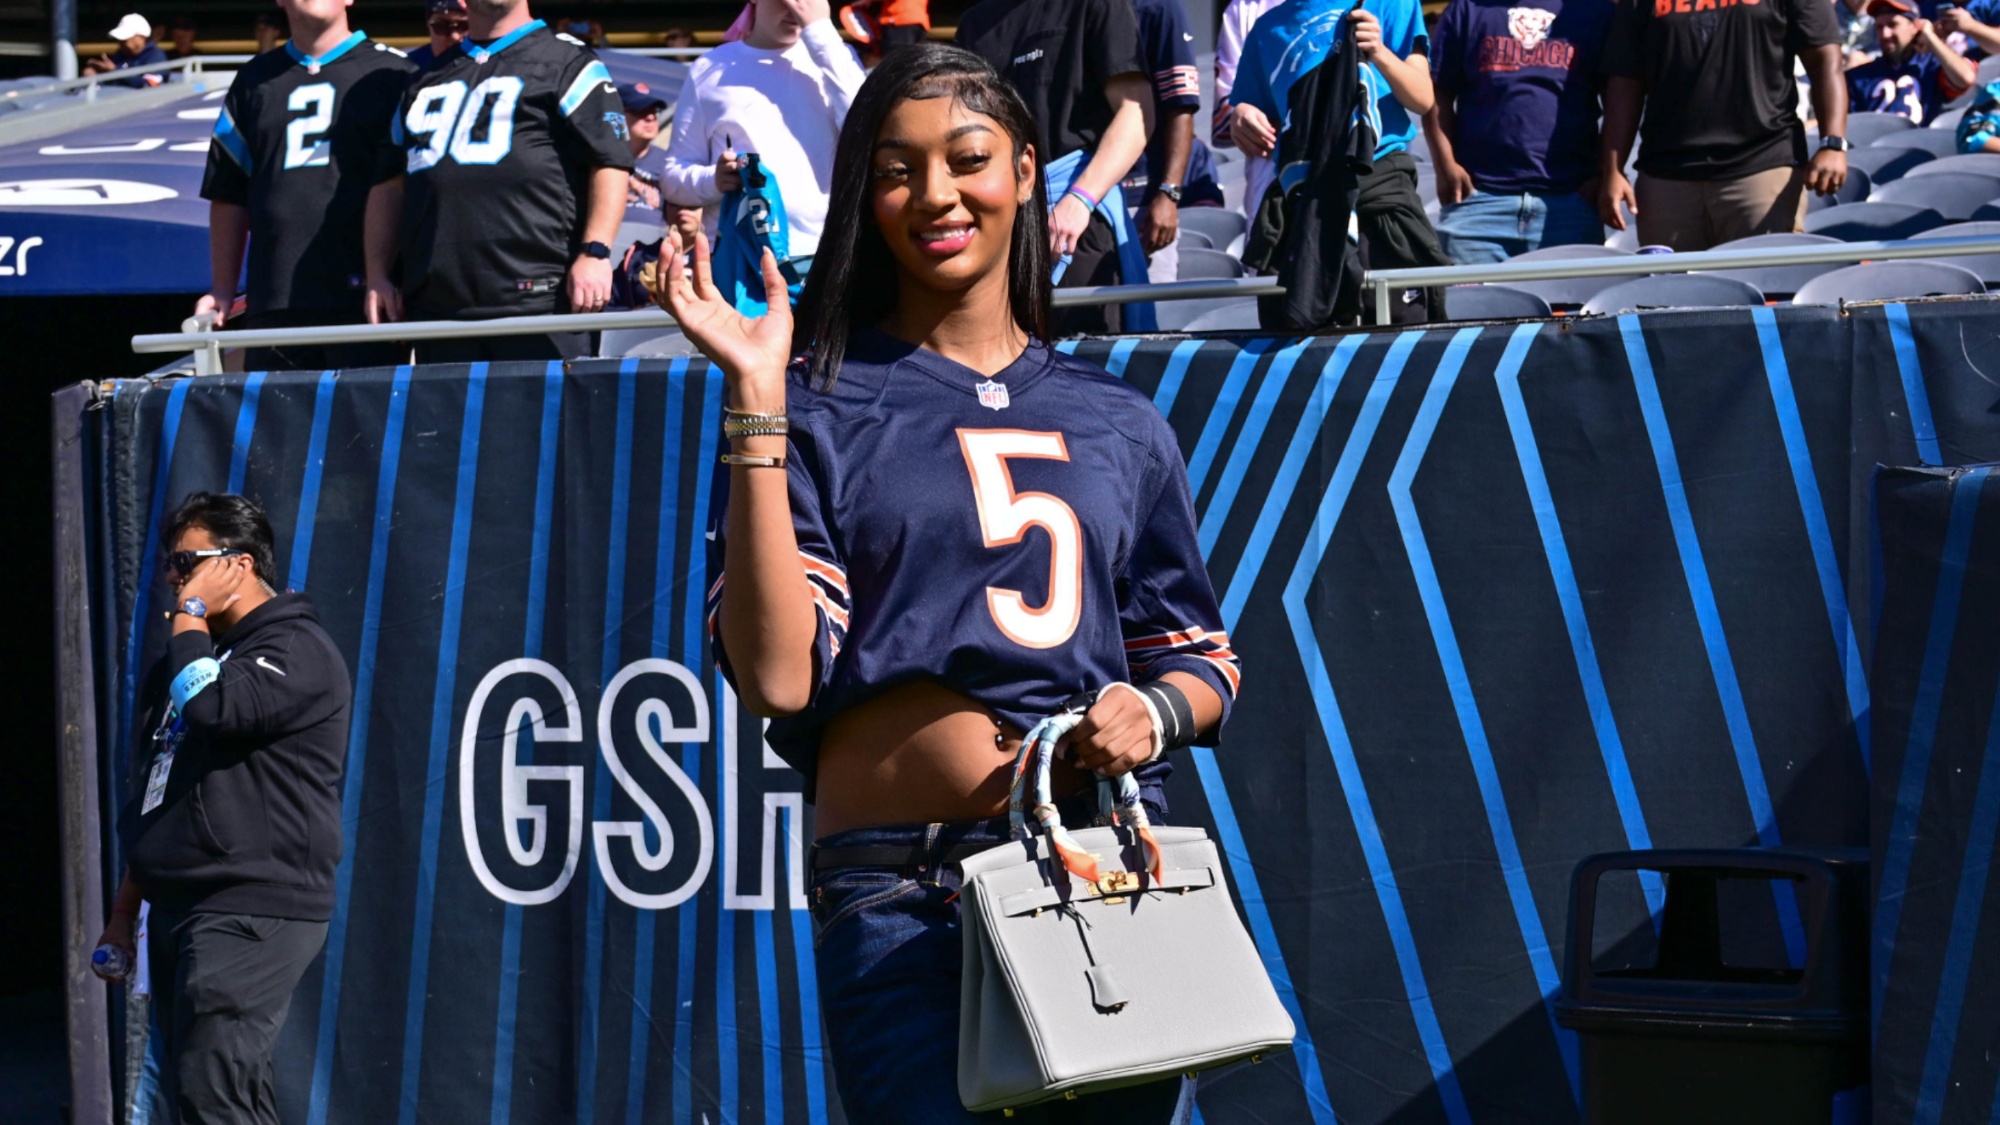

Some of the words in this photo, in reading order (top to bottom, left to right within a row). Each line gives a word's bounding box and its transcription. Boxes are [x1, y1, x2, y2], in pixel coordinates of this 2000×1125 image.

[284, 82, 336, 169] 2
[406, 76, 524, 174] 90
[1871, 74, 1923, 124] 23
[984, 392, 1005, 404] NFL
[955, 427, 1083, 649] 5
